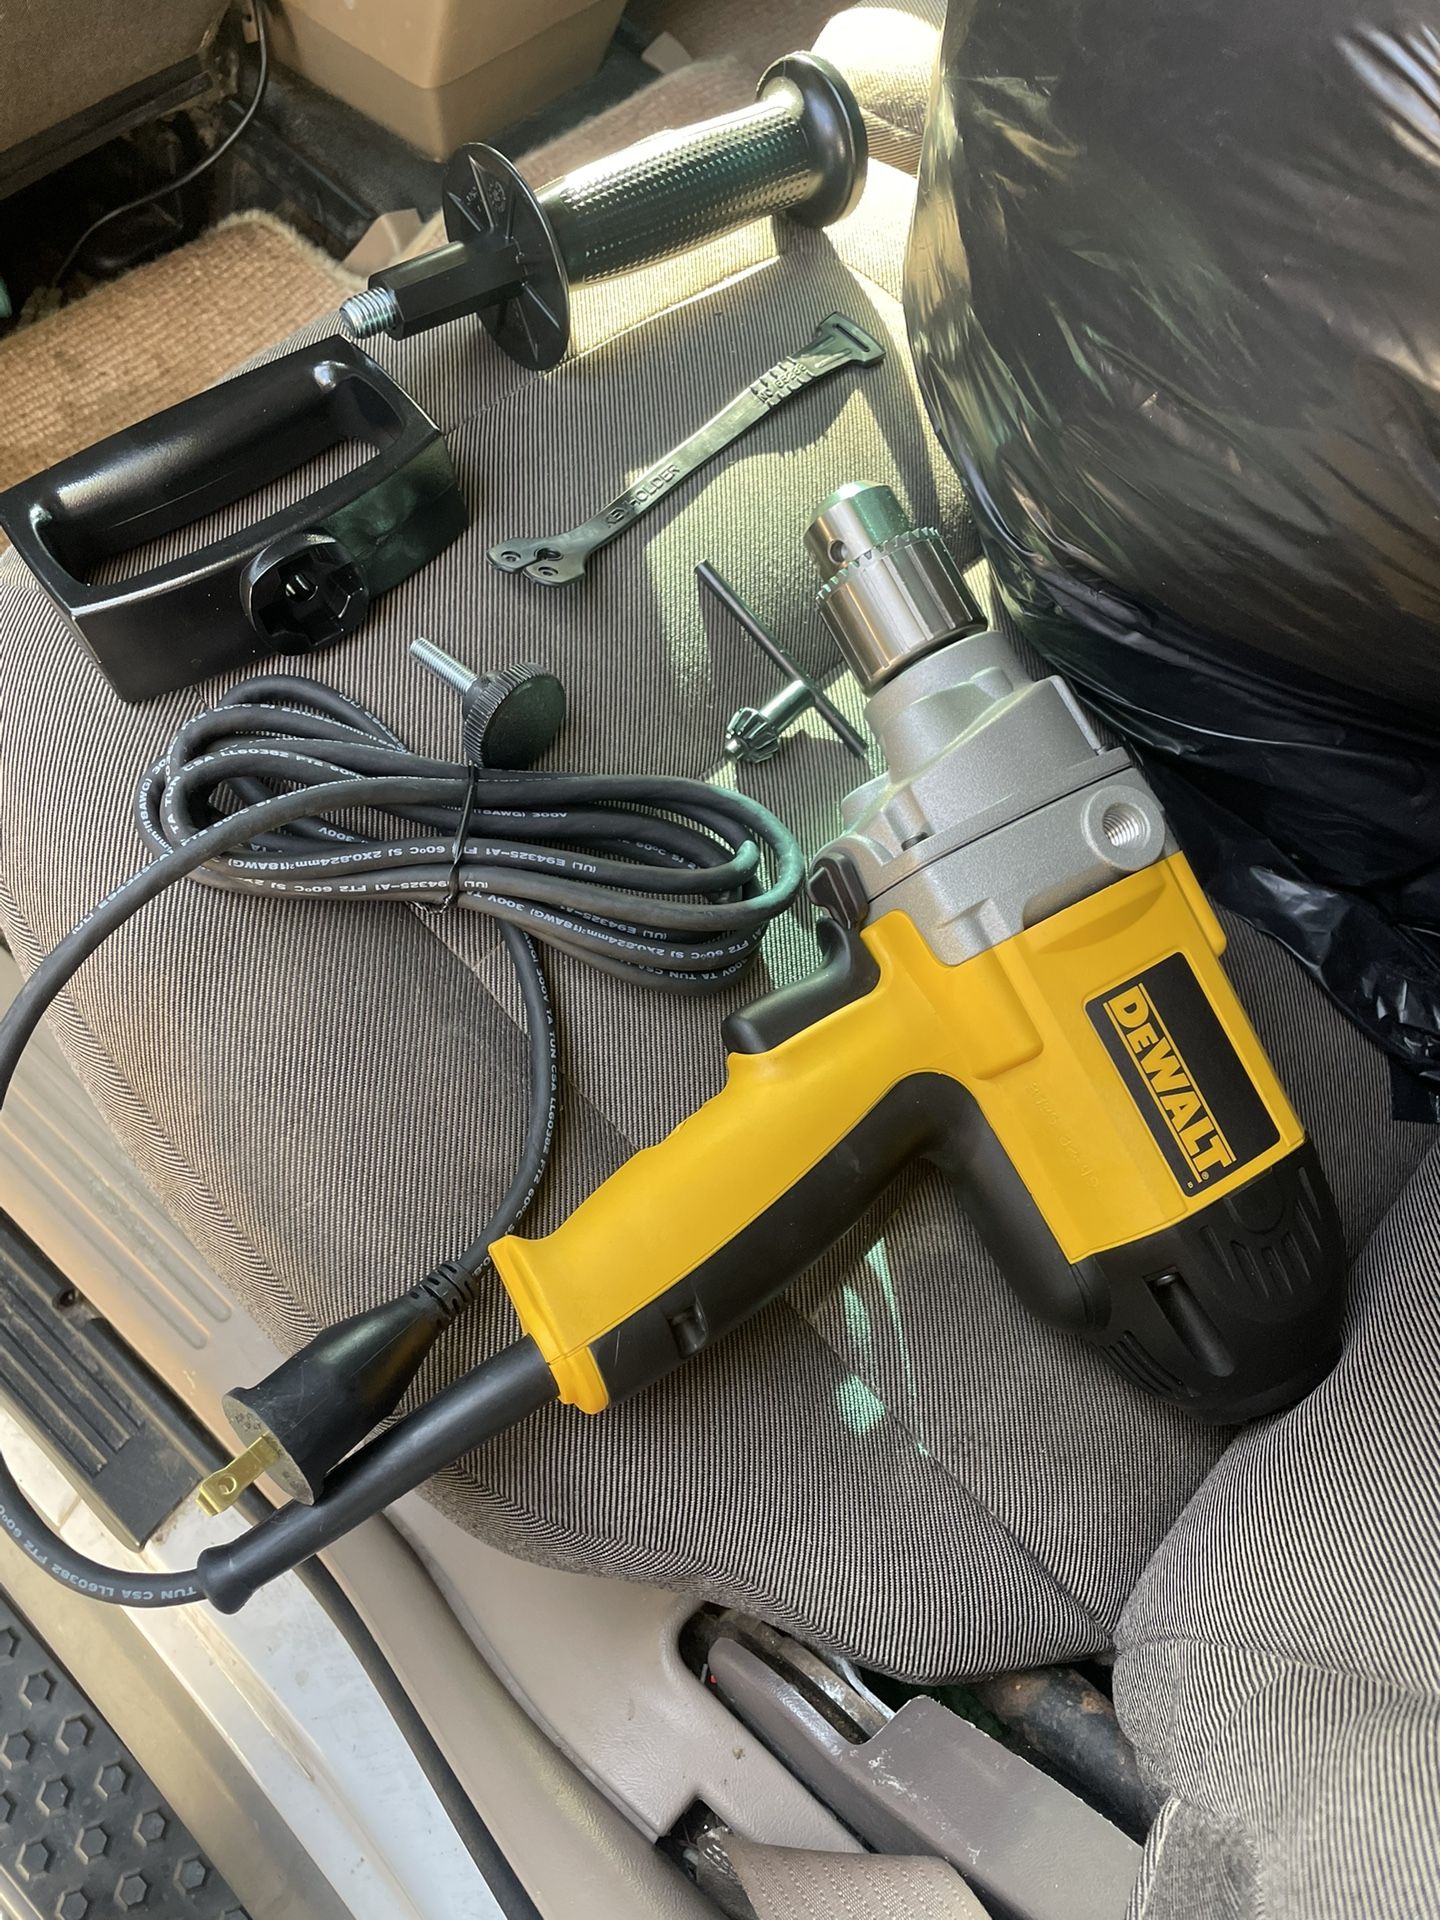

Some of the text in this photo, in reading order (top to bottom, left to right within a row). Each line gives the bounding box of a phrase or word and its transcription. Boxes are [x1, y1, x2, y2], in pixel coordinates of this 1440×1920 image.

[182, 756, 214, 772] CSA
[164, 775, 181, 807] TUN
[167, 813, 180, 834] TA
[388, 848, 403, 857] SJ
[485, 847, 566, 867] E94325-A1
[572, 860, 597, 873] (UL)
[271, 882, 287, 890] SJ
[340, 884, 367, 892] FT2
[375, 880, 450, 891] 94325-A1
[463, 880, 489, 889] (UL)
[488, 894, 526, 912] 300V
[643, 929, 667, 940] (UL)
[728, 940, 749, 954] FT2
[669, 970, 697, 980] TUN
[1107, 983, 1233, 1174] DEWALT
[24, 1539, 48, 1567] FT2
[51, 1563, 115, 1597] LL60382
[121, 1590, 153, 1600] CSA
[161, 1586, 196, 1600] TUN
